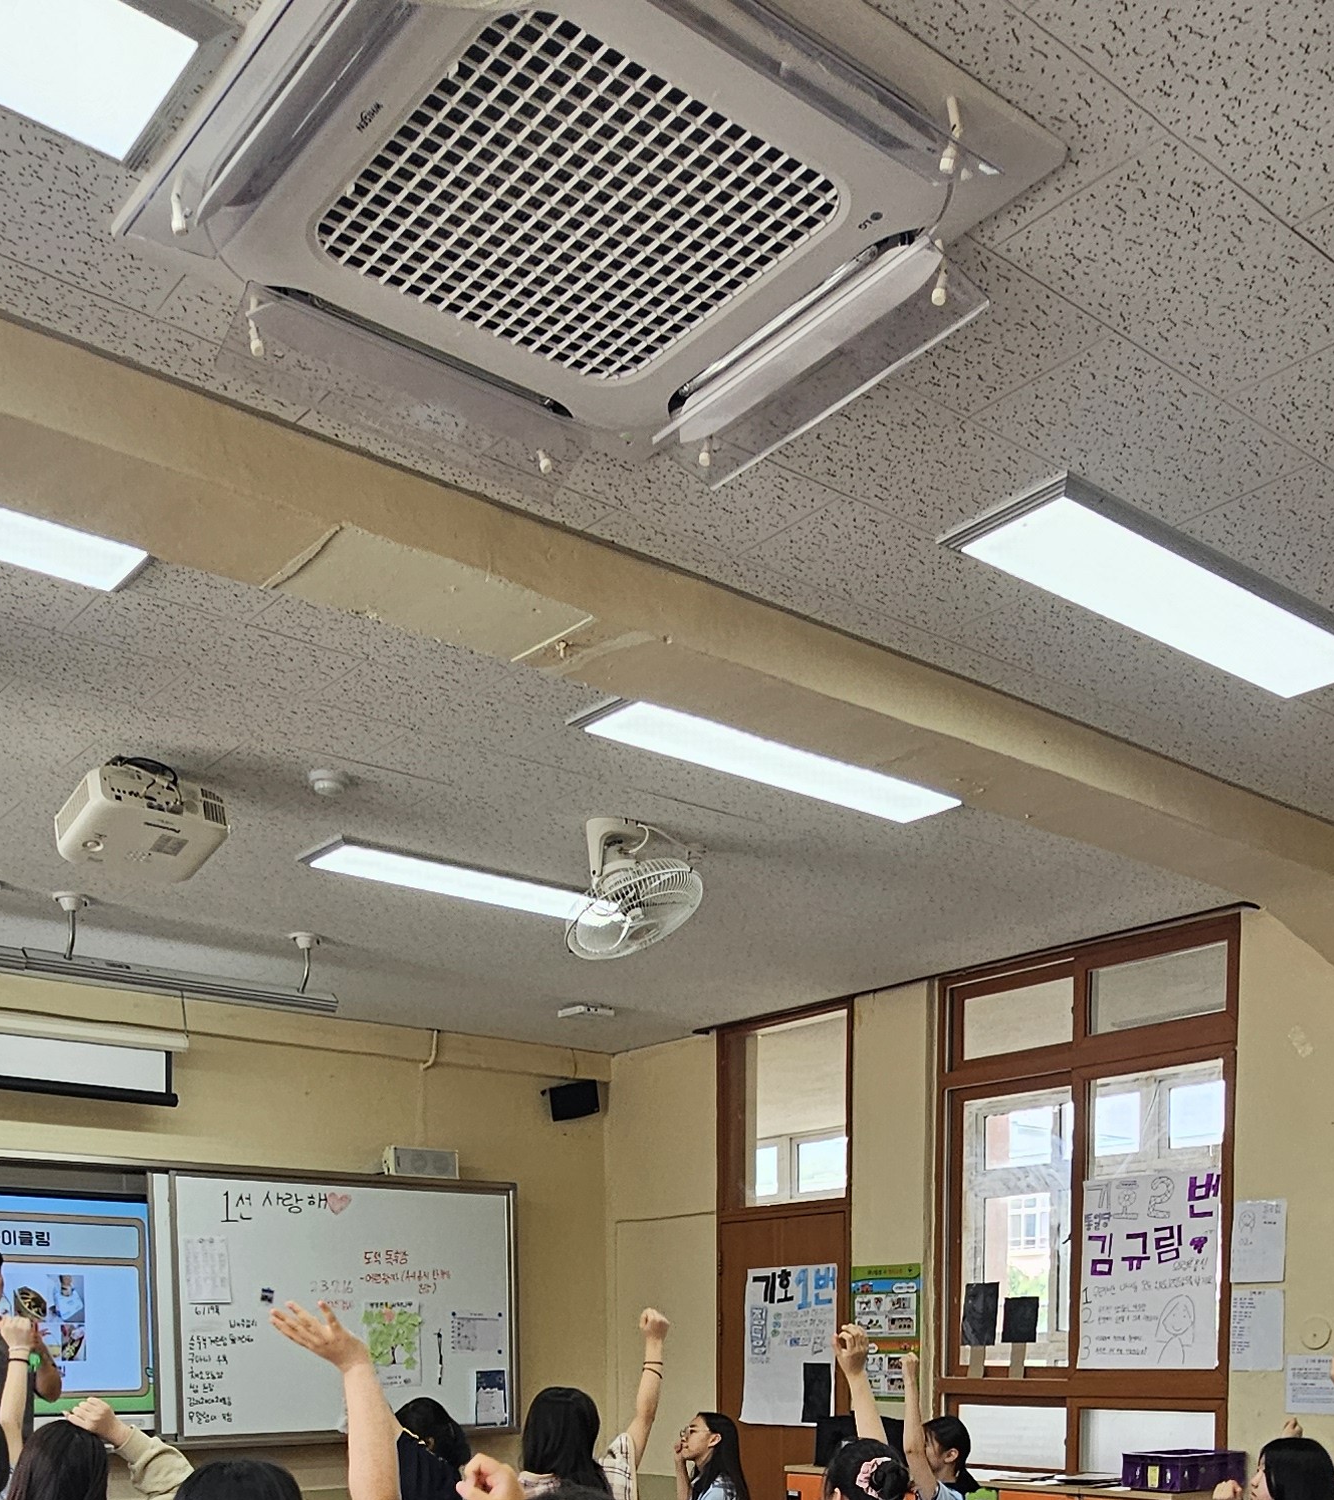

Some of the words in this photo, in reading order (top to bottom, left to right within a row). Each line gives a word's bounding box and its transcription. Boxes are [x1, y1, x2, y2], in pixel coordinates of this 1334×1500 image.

[262, 1191, 328, 1214] 사랑해
[1088, 1224, 1182, 1276] 김규림
[752, 1269, 794, 1304] 기호
[794, 1267, 835, 1310] 1번
